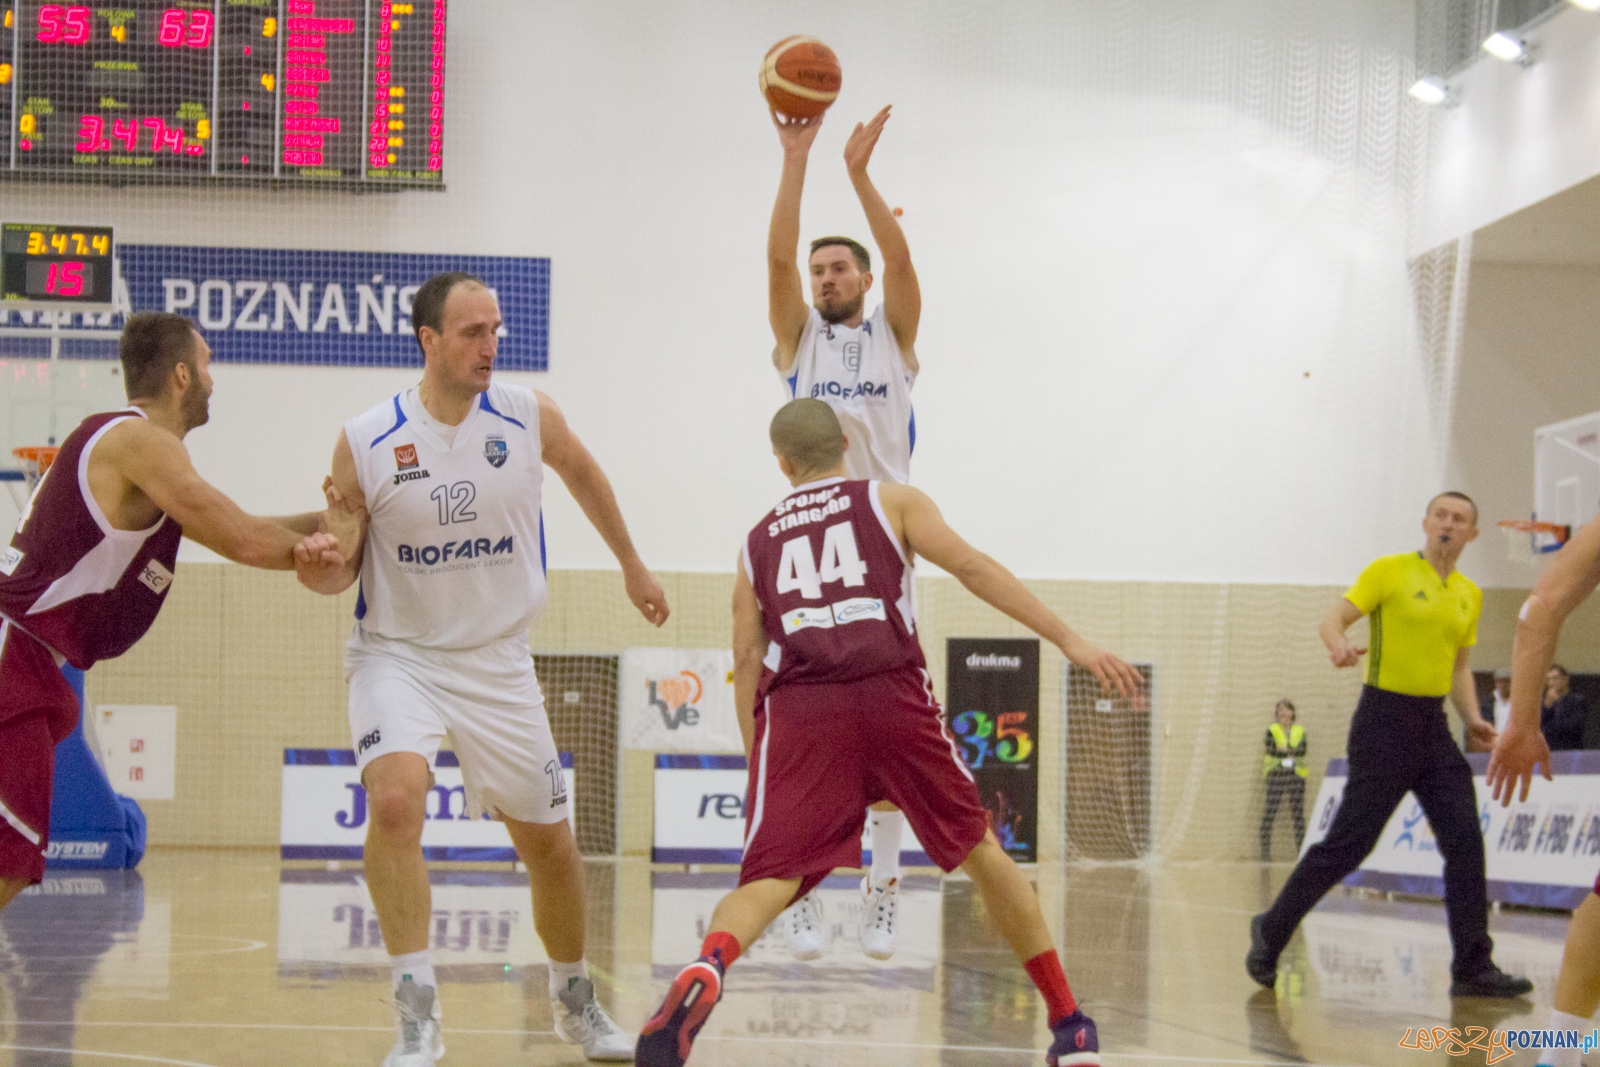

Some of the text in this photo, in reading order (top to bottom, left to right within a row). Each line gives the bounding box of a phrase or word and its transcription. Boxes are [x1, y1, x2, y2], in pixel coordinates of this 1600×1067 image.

[37, 5, 91, 44] 55
[111, 25, 126, 43] 4
[158, 9, 214, 48] 63
[262, 17, 277, 37] 3
[261, 73, 275, 92] 4
[20, 114, 36, 134] 0
[196, 119, 211, 139] 5
[27, 232, 109, 256] 3.47.4
[46, 262, 84, 297] 15
[162, 274, 508, 337] POZNAŃS
[811, 381, 887, 399] BIOFARM
[430, 480, 477, 526] 12
[768, 495, 851, 538] STARGARD
[397, 536, 513, 566] BIOFARM
[776, 520, 868, 599] 44
[429, 561, 481, 576] PRODUCENT
[965, 653, 1022, 669] drukma
[358, 729, 381, 755] PBG
